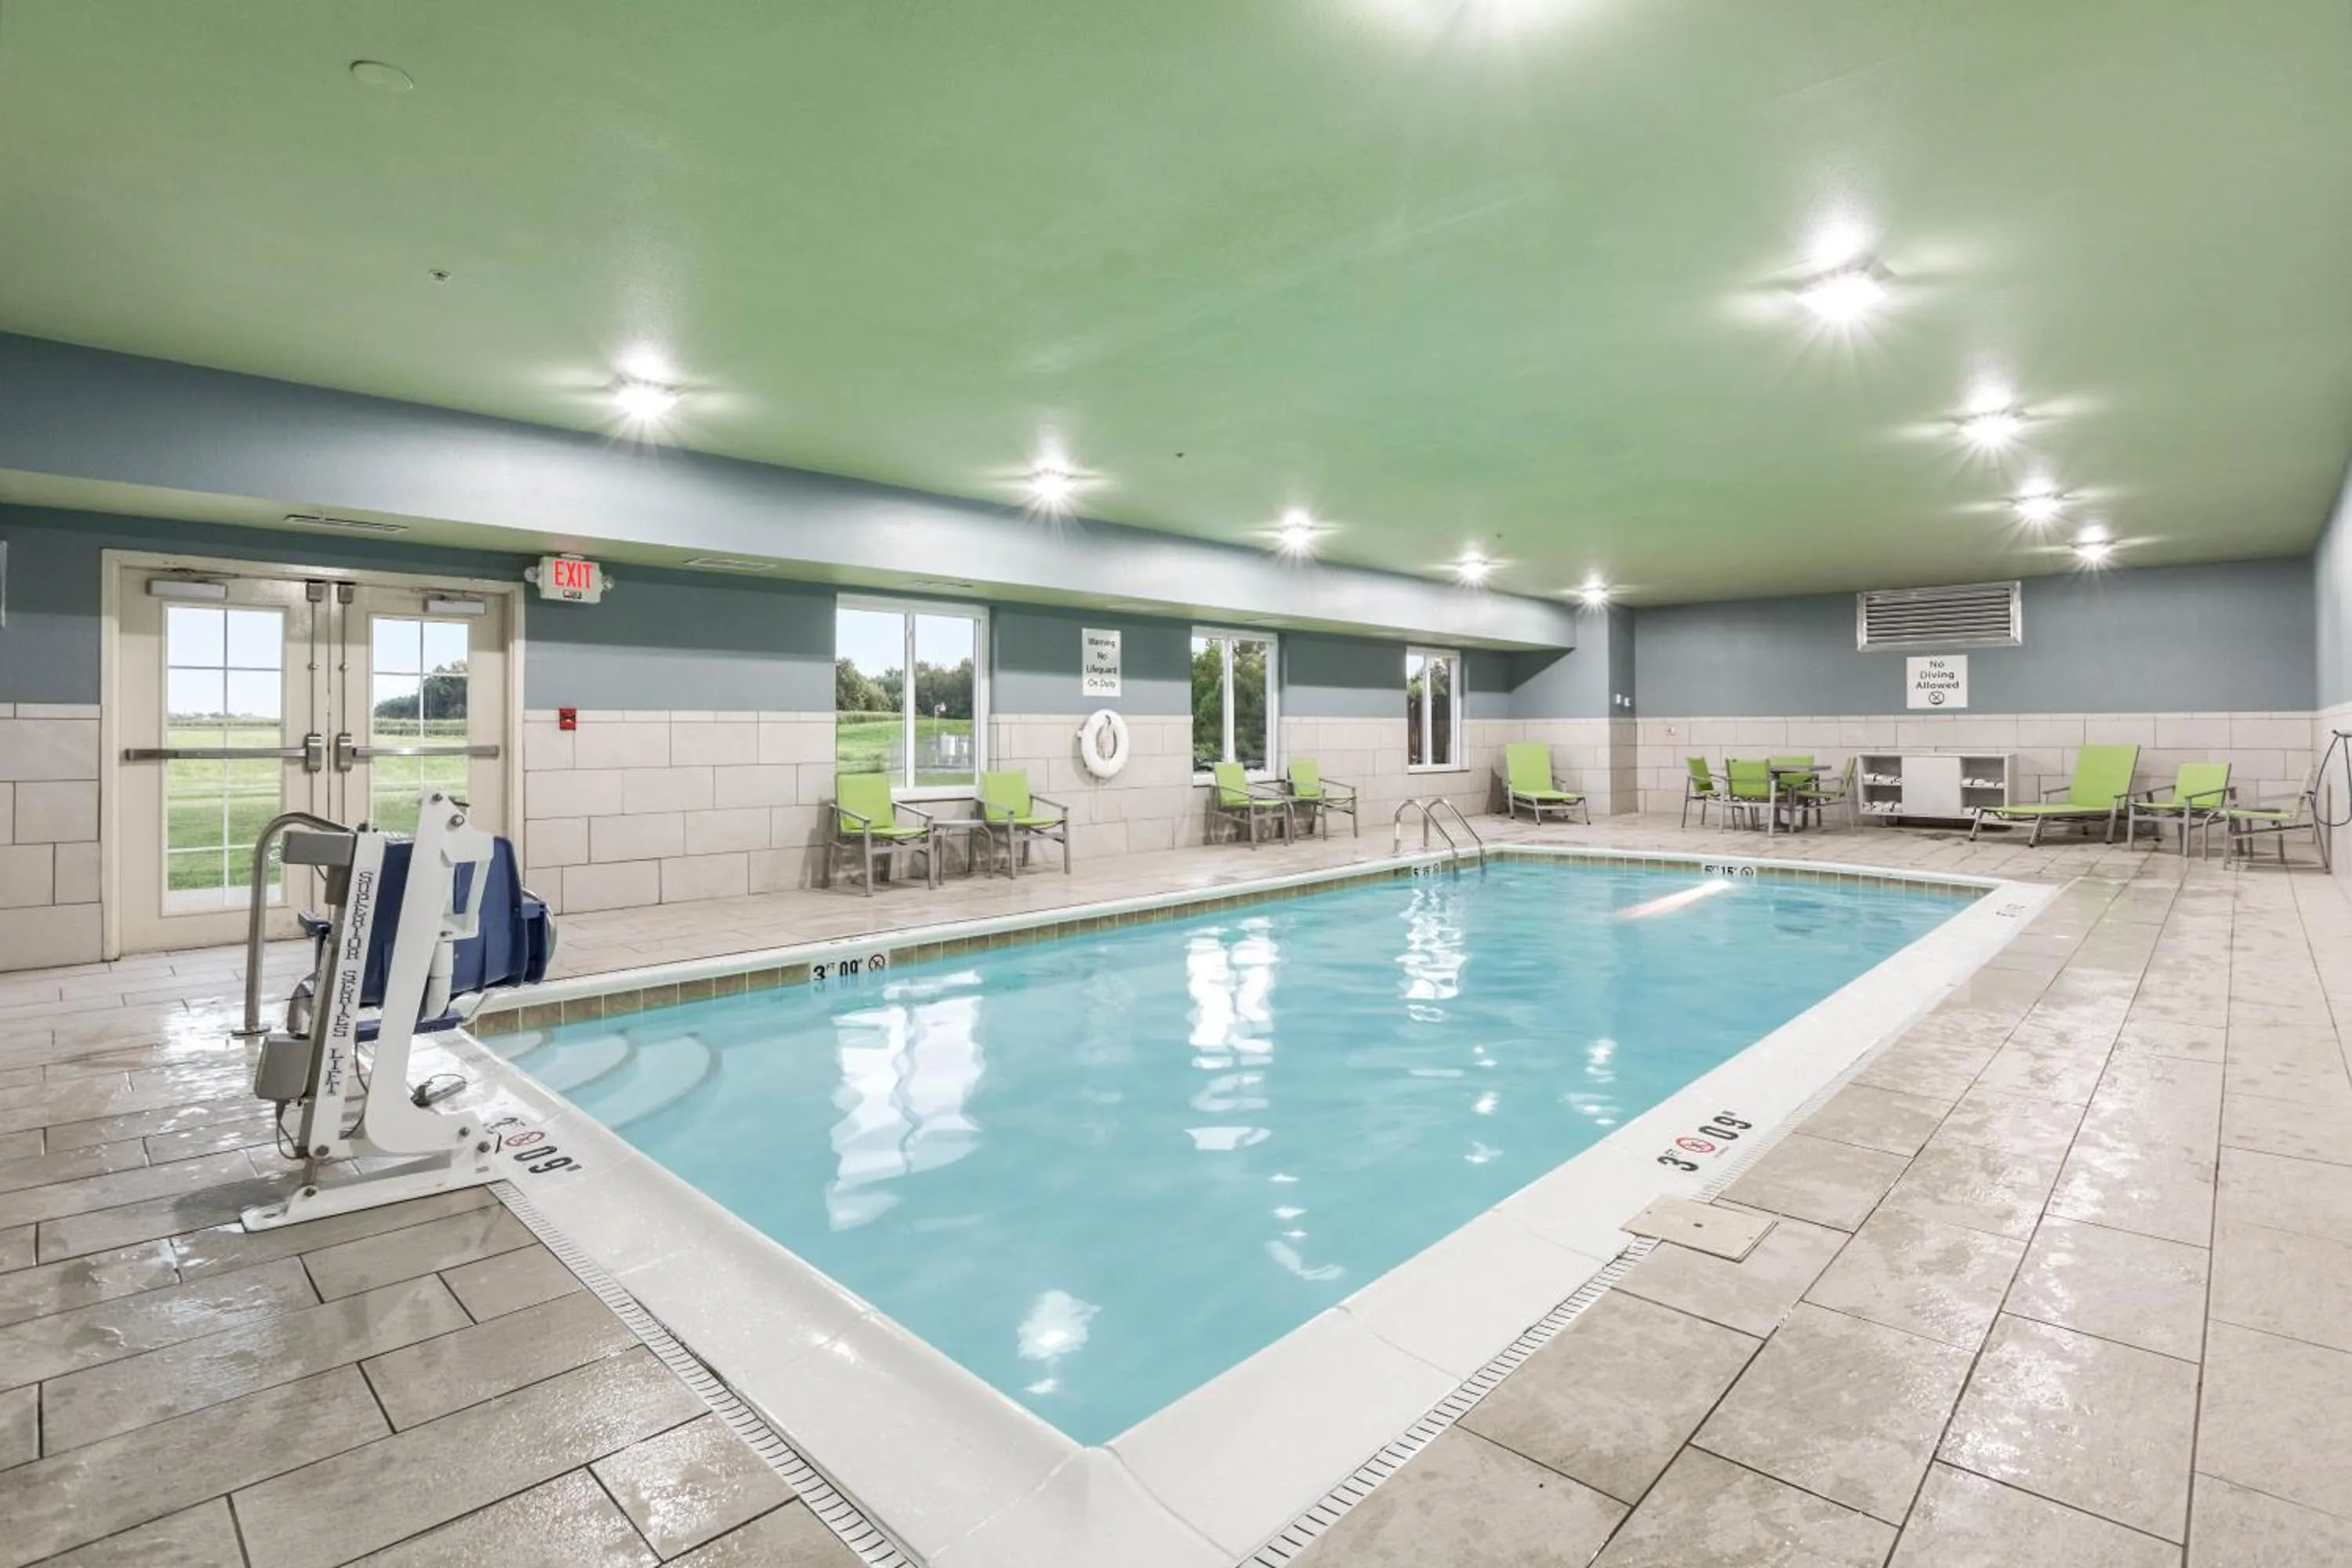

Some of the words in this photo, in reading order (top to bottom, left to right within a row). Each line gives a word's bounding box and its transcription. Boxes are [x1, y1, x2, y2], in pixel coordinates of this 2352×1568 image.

[554, 560, 593, 589] EXIT
[1087, 637, 1116, 648] Warning
[1097, 652, 1107, 660] No
[1086, 664, 1117, 674] Lifeguard
[1929, 660, 1945, 669] No
[1919, 670, 1955, 680] Diving
[1087, 678, 1098, 687] On
[1100, 679, 1116, 688] Duty
[1915, 680, 1959, 690] Allowed
[346, 870, 374, 960] SUPERIOR
[332, 970, 358, 1037] SERIES
[325, 1047, 344, 1096] LIFT
